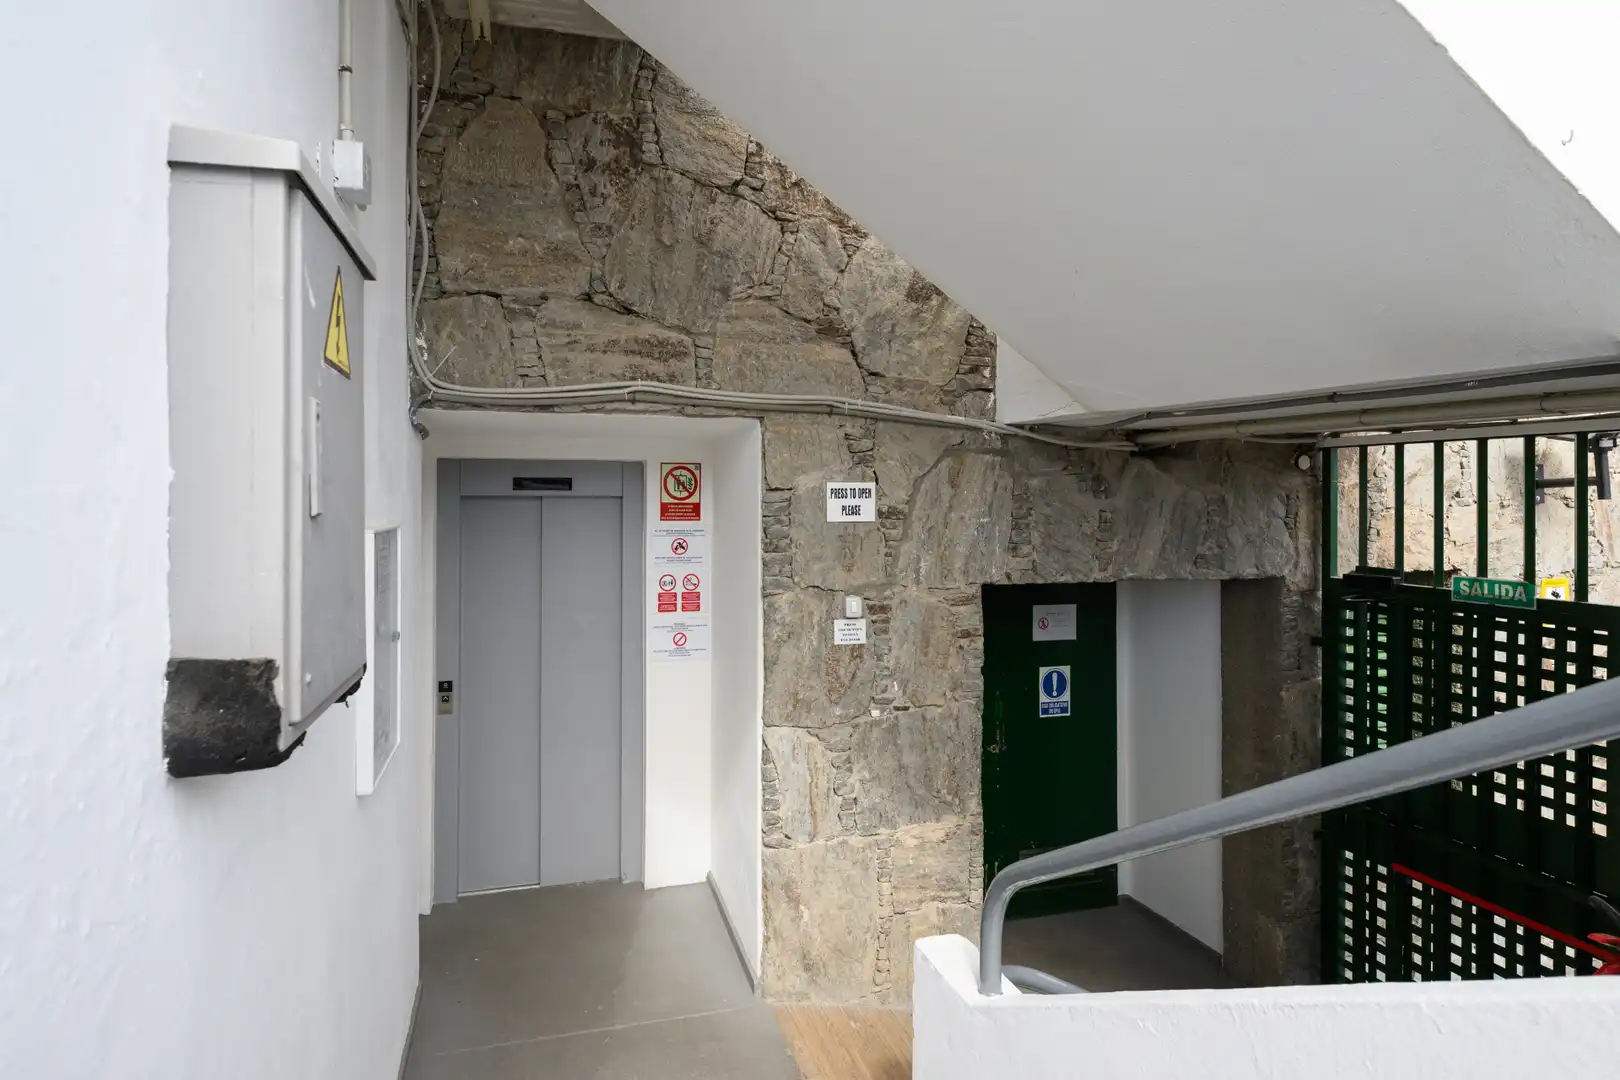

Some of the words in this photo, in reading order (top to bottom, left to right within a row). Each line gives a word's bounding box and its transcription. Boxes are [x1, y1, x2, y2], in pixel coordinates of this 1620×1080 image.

[830, 487, 848, 499] PRESS
[849, 487, 857, 499] TO
[858, 487, 872, 499] OPEN
[841, 504, 861, 516] PLEASE
[1459, 580, 1528, 602] SALIDA
